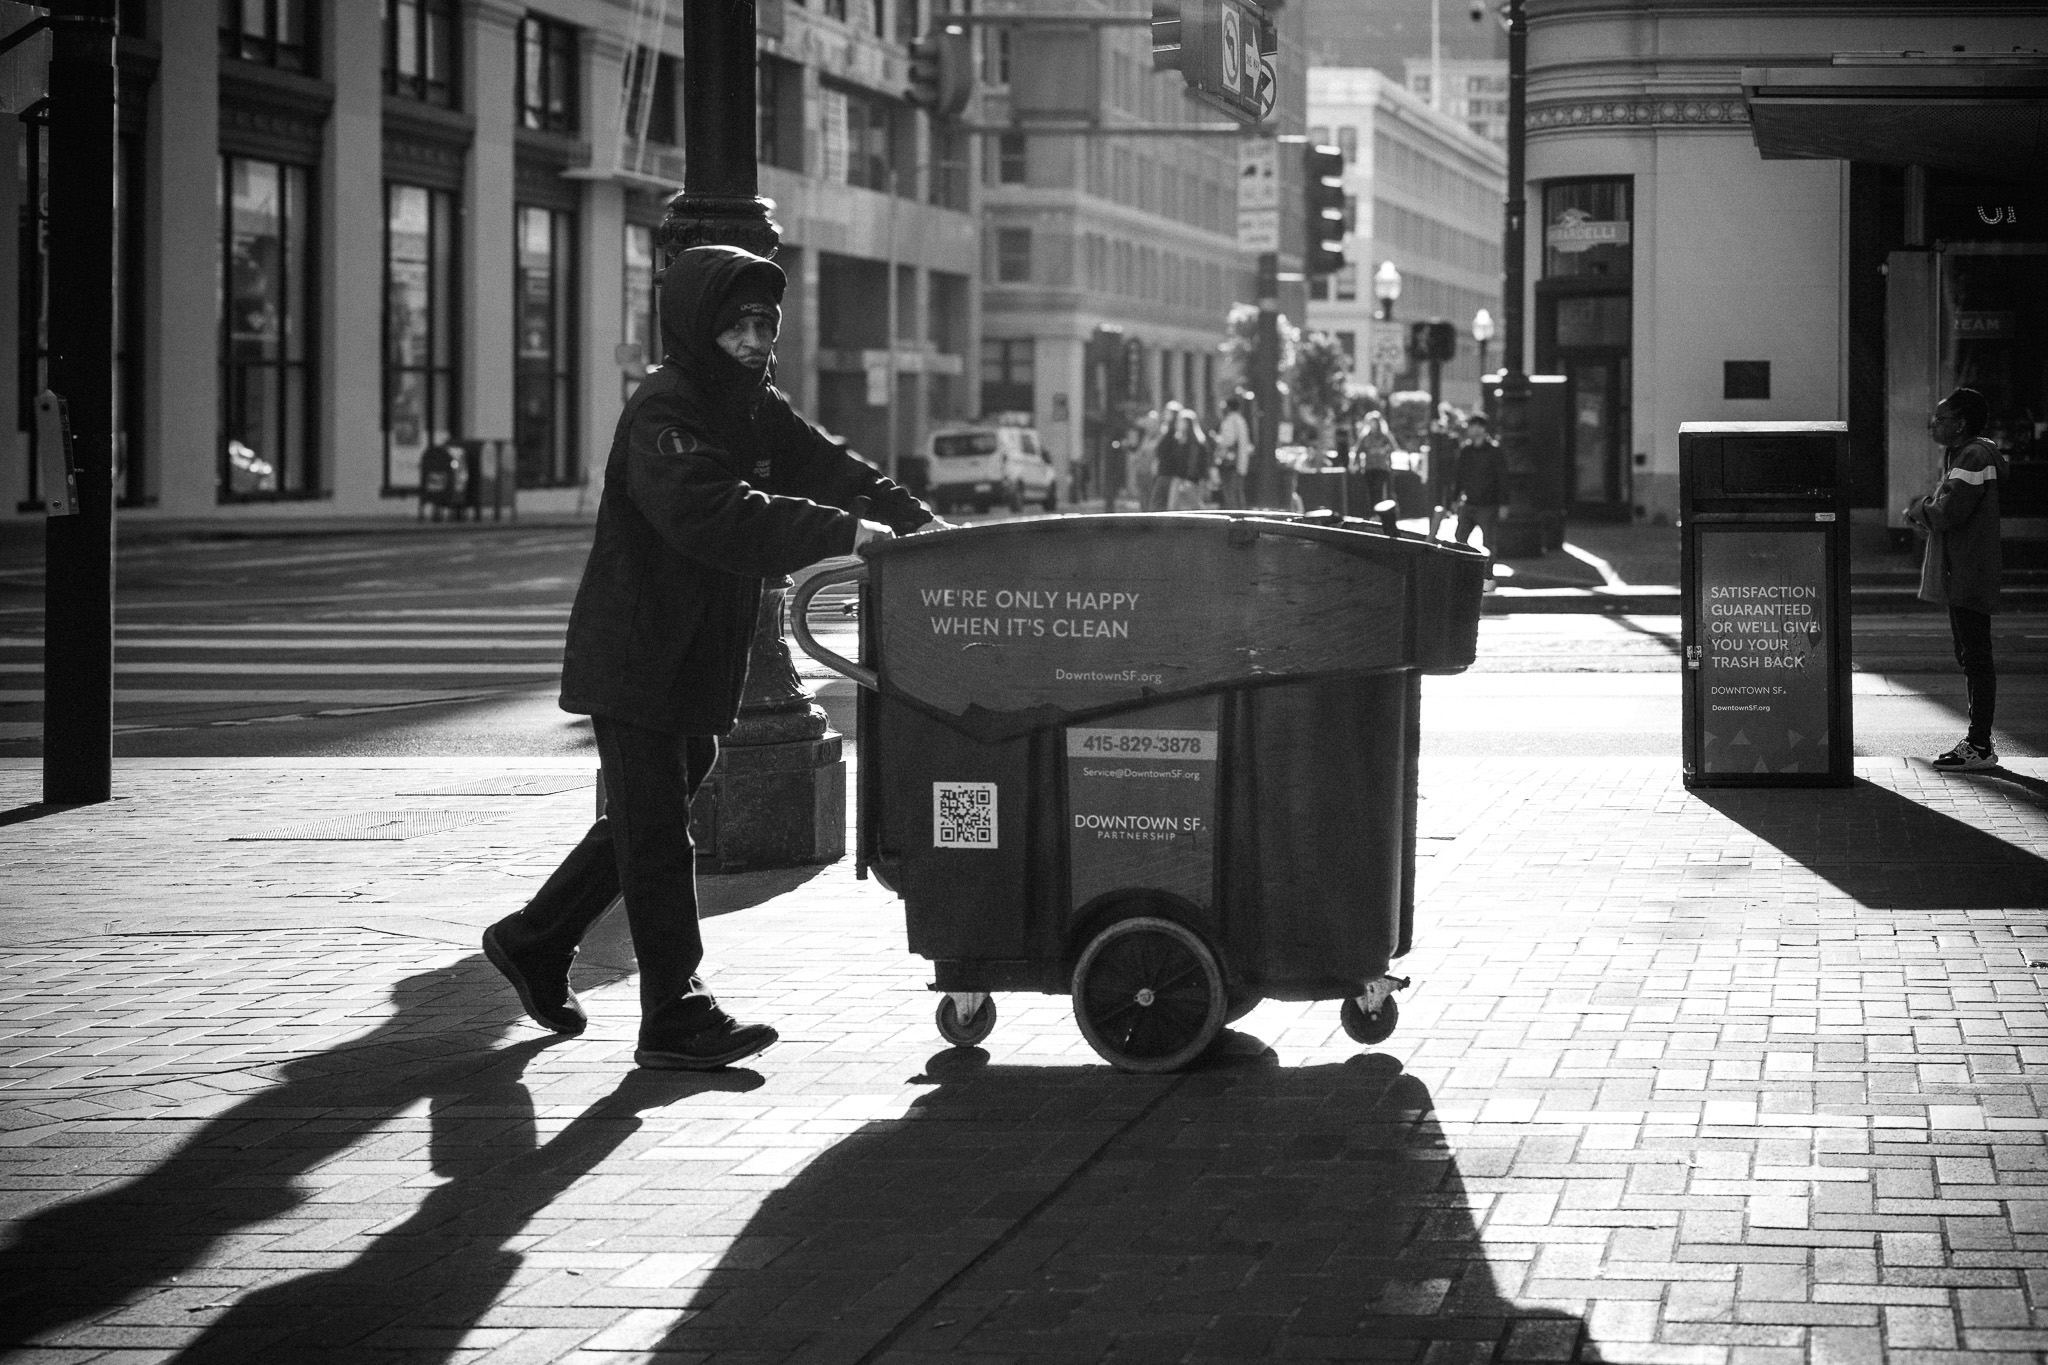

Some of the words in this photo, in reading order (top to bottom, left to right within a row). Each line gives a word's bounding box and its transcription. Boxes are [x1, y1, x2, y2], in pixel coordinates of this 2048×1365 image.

[1711, 586, 1816, 599] SATISFACTION
[921, 589, 988, 608] WE'RE
[995, 590, 1059, 609] ONLY
[1066, 592, 1140, 611] HAPPY
[1711, 604, 1812, 616] GUARANTEED
[931, 617, 999, 636] WHEN
[1007, 618, 1045, 637] IT'S
[1052, 619, 1128, 638] CLEAN
[1711, 621, 1733, 633] OR
[1737, 621, 1779, 634] WE'LL
[1783, 621, 1818, 634] GIVE
[1711, 638, 1743, 651] YOU
[1747, 638, 1789, 651] YOUR
[1711, 656, 1759, 668] TRASH
[1764, 656, 1805, 668] BACK
[1056, 669, 1162, 685] DowntownSF.org
[1711, 686, 1770, 695] DOWNTOWN
[1712, 704, 1771, 713] DowntownSF.org
[1083, 735, 1201, 754] 415-829-3878
[1083, 767, 1200, 781] Service@DowntownSF.org
[1075, 814, 1178, 830] DOWNTOWN
[1098, 831, 1177, 841] PARTNERSHIP
